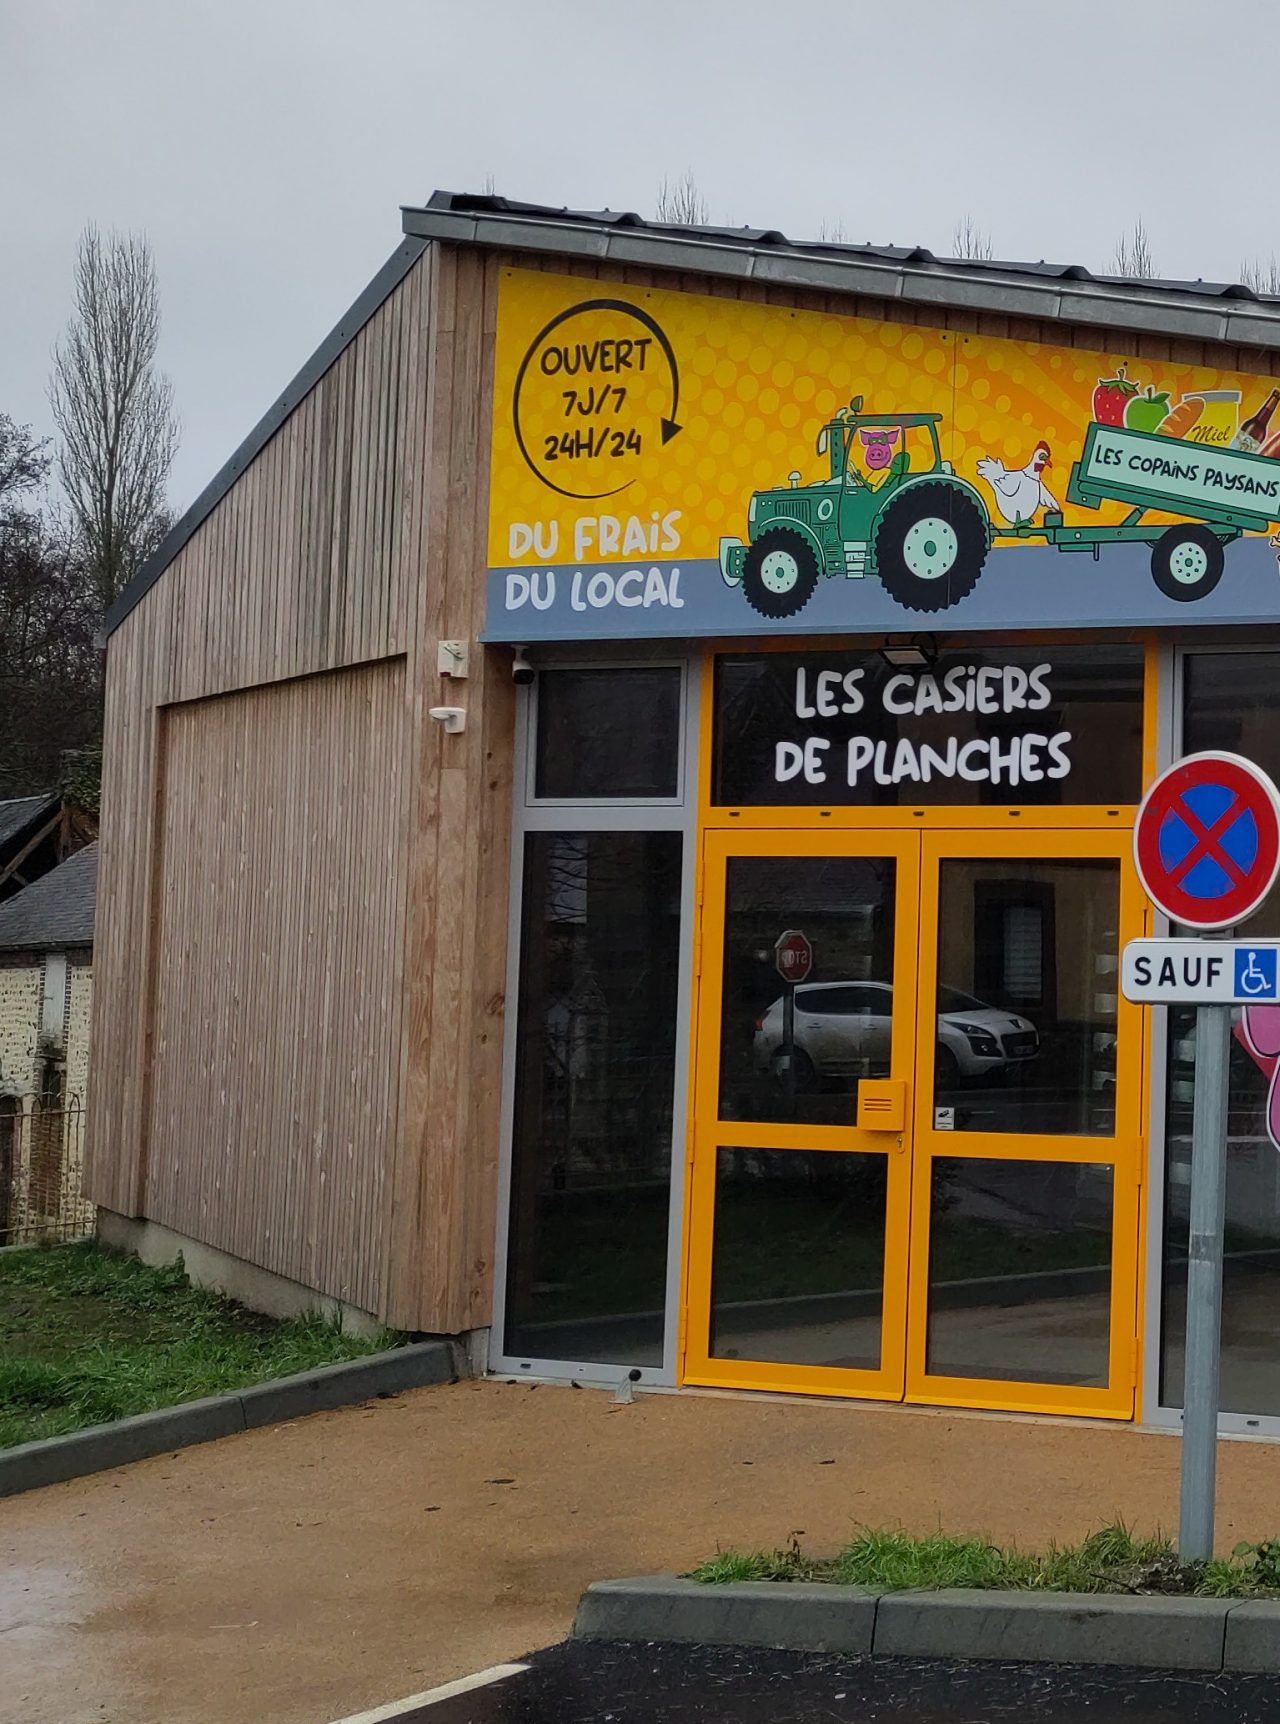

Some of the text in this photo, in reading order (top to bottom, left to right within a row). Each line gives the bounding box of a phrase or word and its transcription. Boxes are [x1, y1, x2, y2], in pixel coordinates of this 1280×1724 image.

[540, 338, 652, 376] OUVERT
[562, 383, 627, 417] 7J/7
[544, 427, 641, 461] 24H/24
[1190, 424, 1230, 444] Miel
[1095, 444, 1123, 465] LES
[1203, 469, 1280, 498] PAYSANS
[508, 520, 558, 559] DU
[505, 567, 685, 612] DU LOCAL
[795, 666, 865, 719] LES
[775, 731, 1072, 787] DE PLANCHES
[1134, 956, 1223, 988] SAUF
